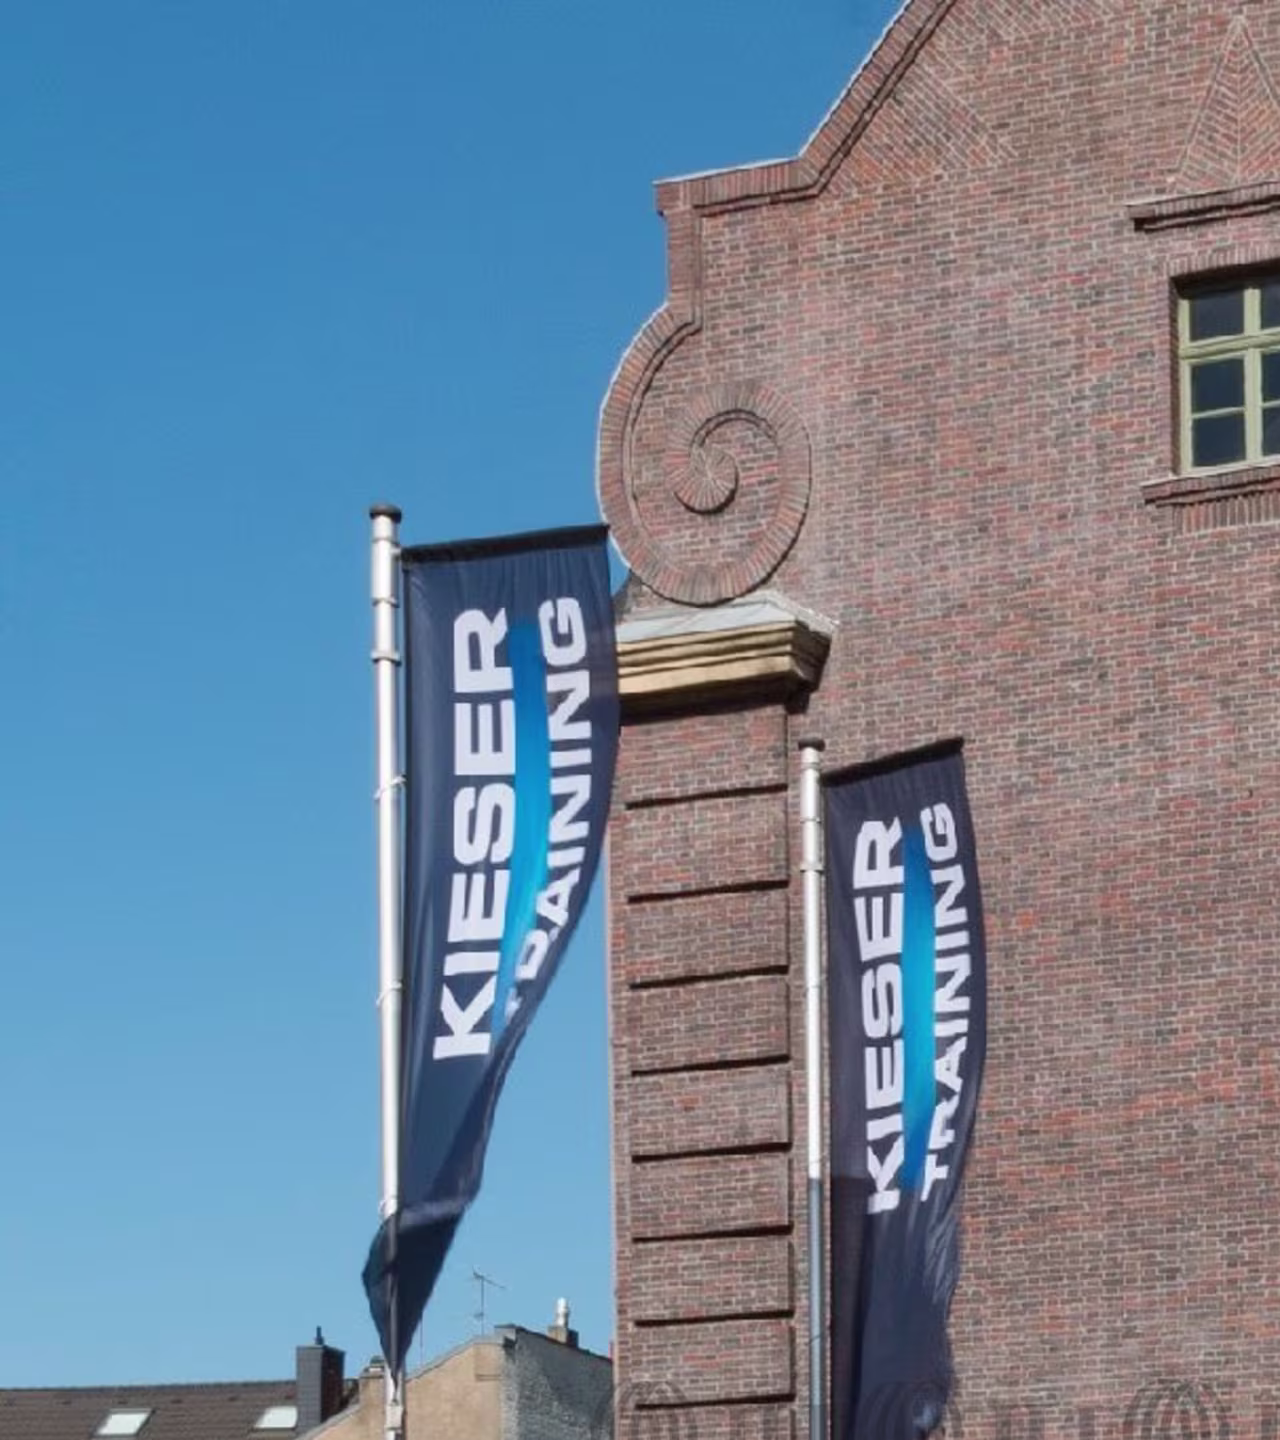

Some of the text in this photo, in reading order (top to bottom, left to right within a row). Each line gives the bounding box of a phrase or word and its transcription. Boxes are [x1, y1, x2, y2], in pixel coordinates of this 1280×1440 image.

[433, 607, 517, 1060] KIESER
[853, 816, 905, 1214] KIESER
[920, 802, 972, 1202] TRAINING
